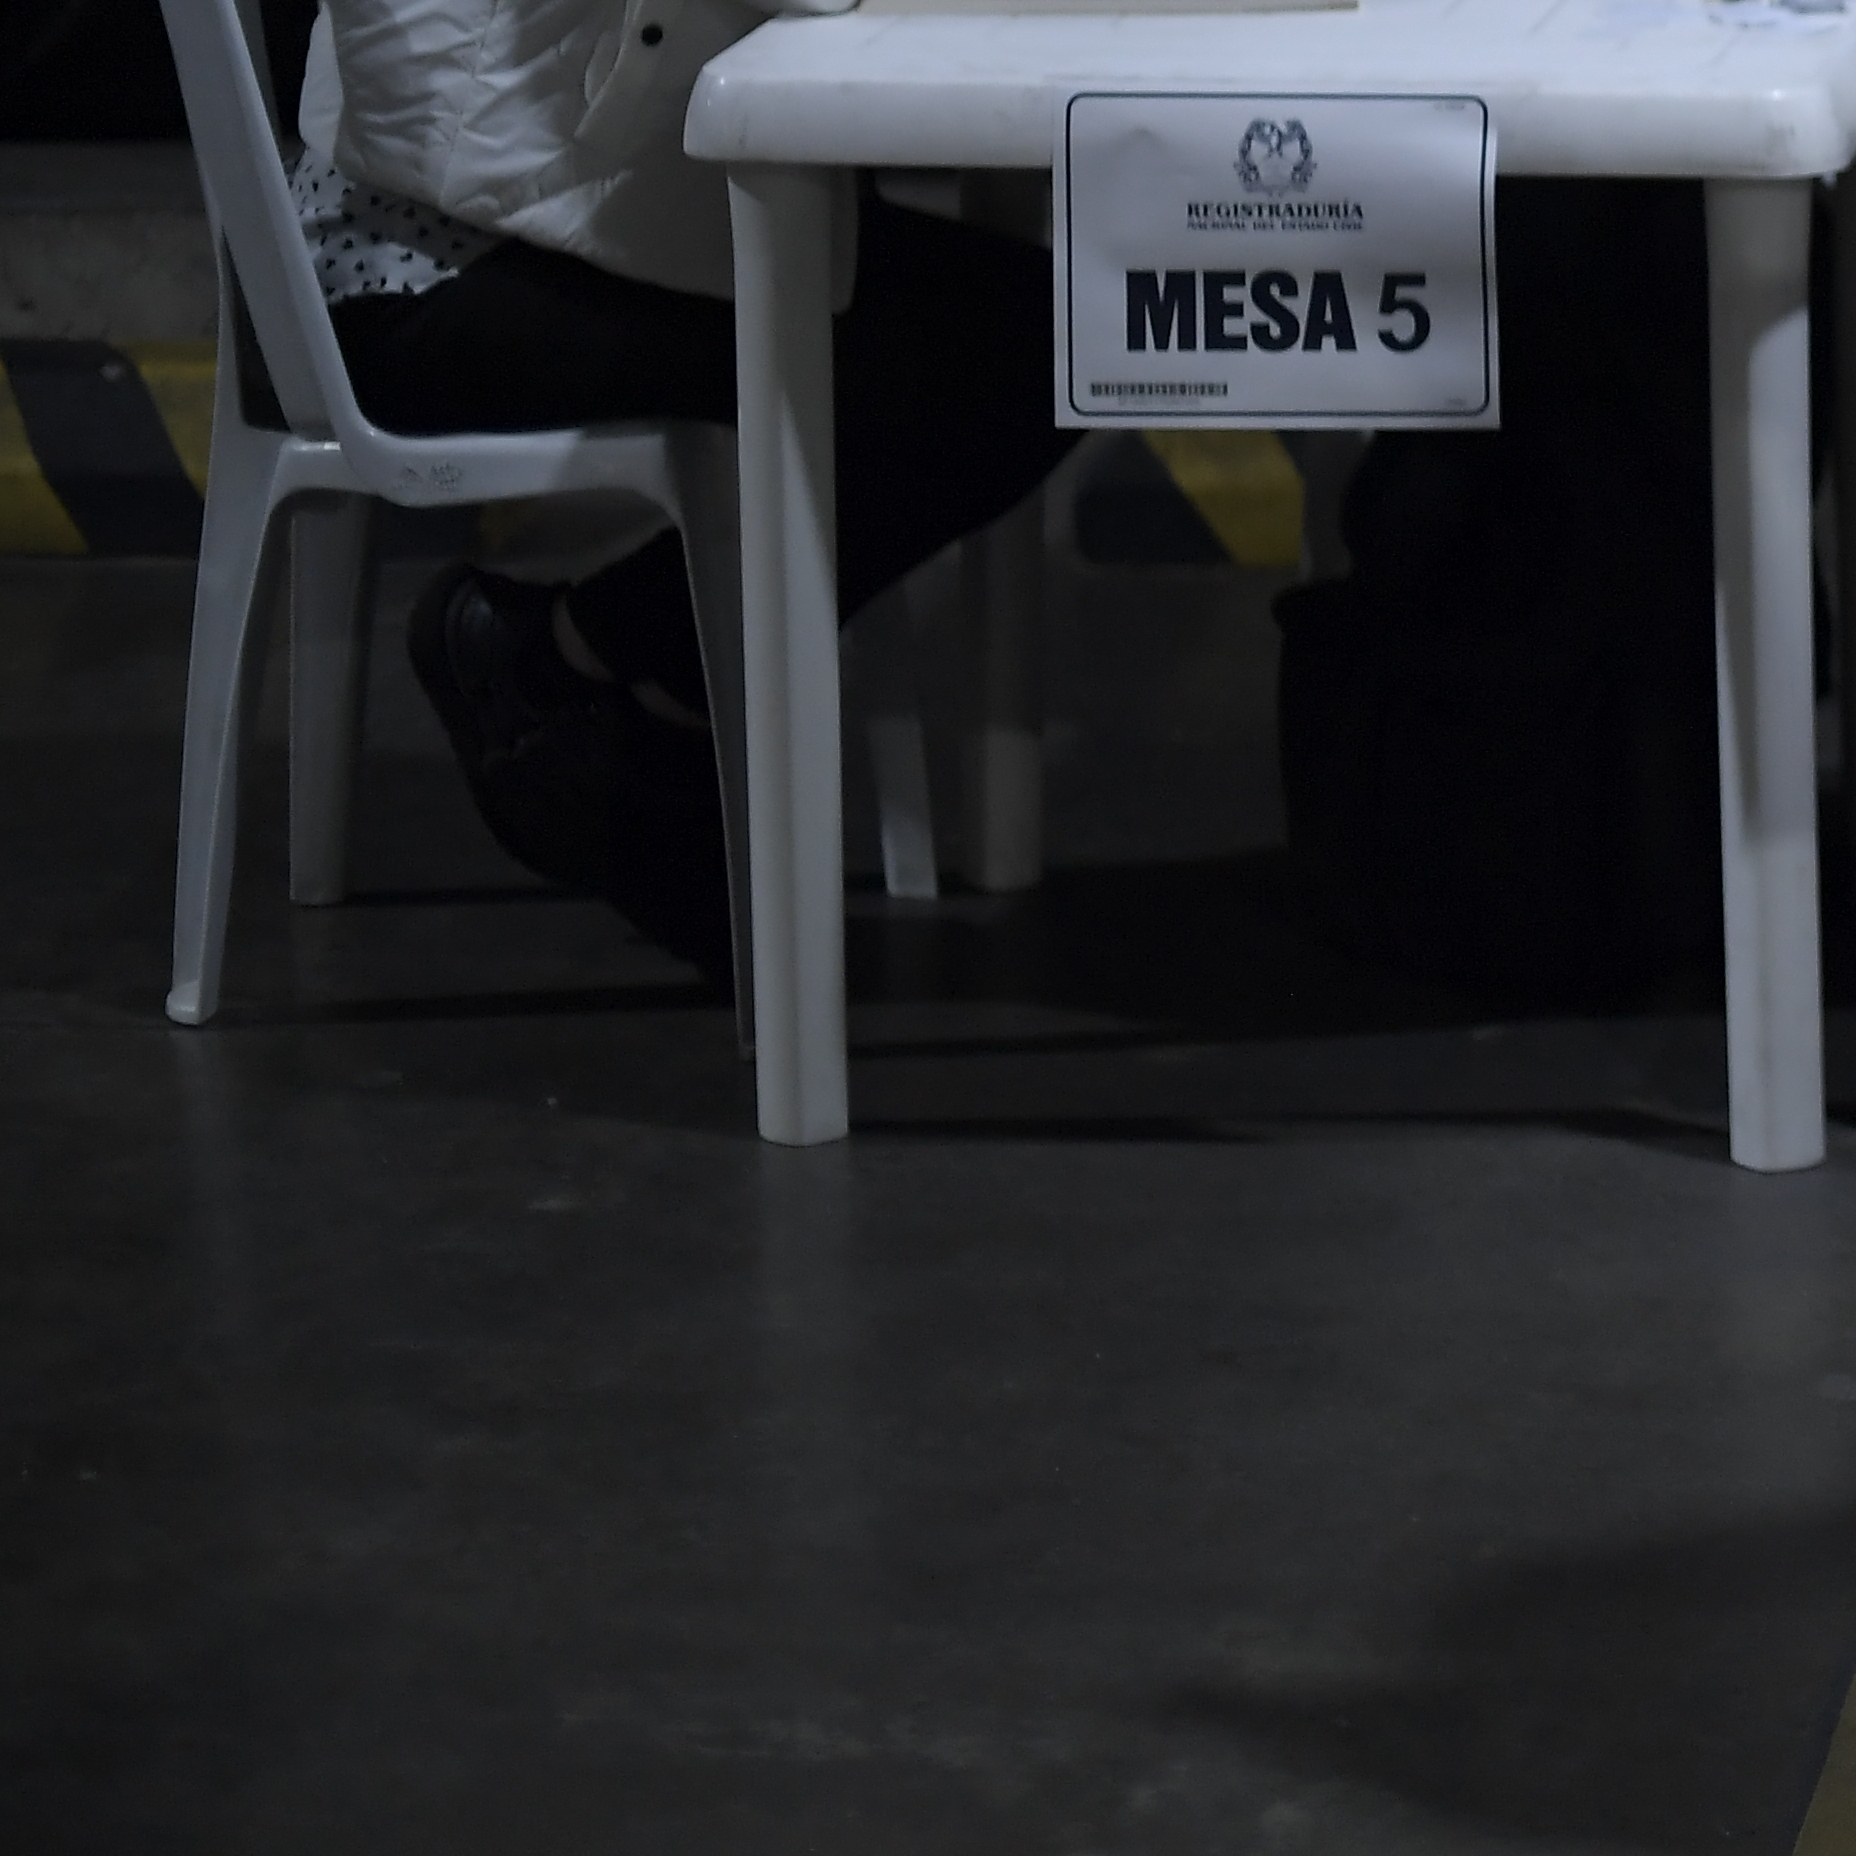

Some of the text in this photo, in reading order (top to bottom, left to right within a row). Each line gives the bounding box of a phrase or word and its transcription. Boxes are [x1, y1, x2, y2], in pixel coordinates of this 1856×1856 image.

[1187, 198, 1364, 220] REGISTRADURÍA
[1125, 269, 1432, 353] MESA 5
